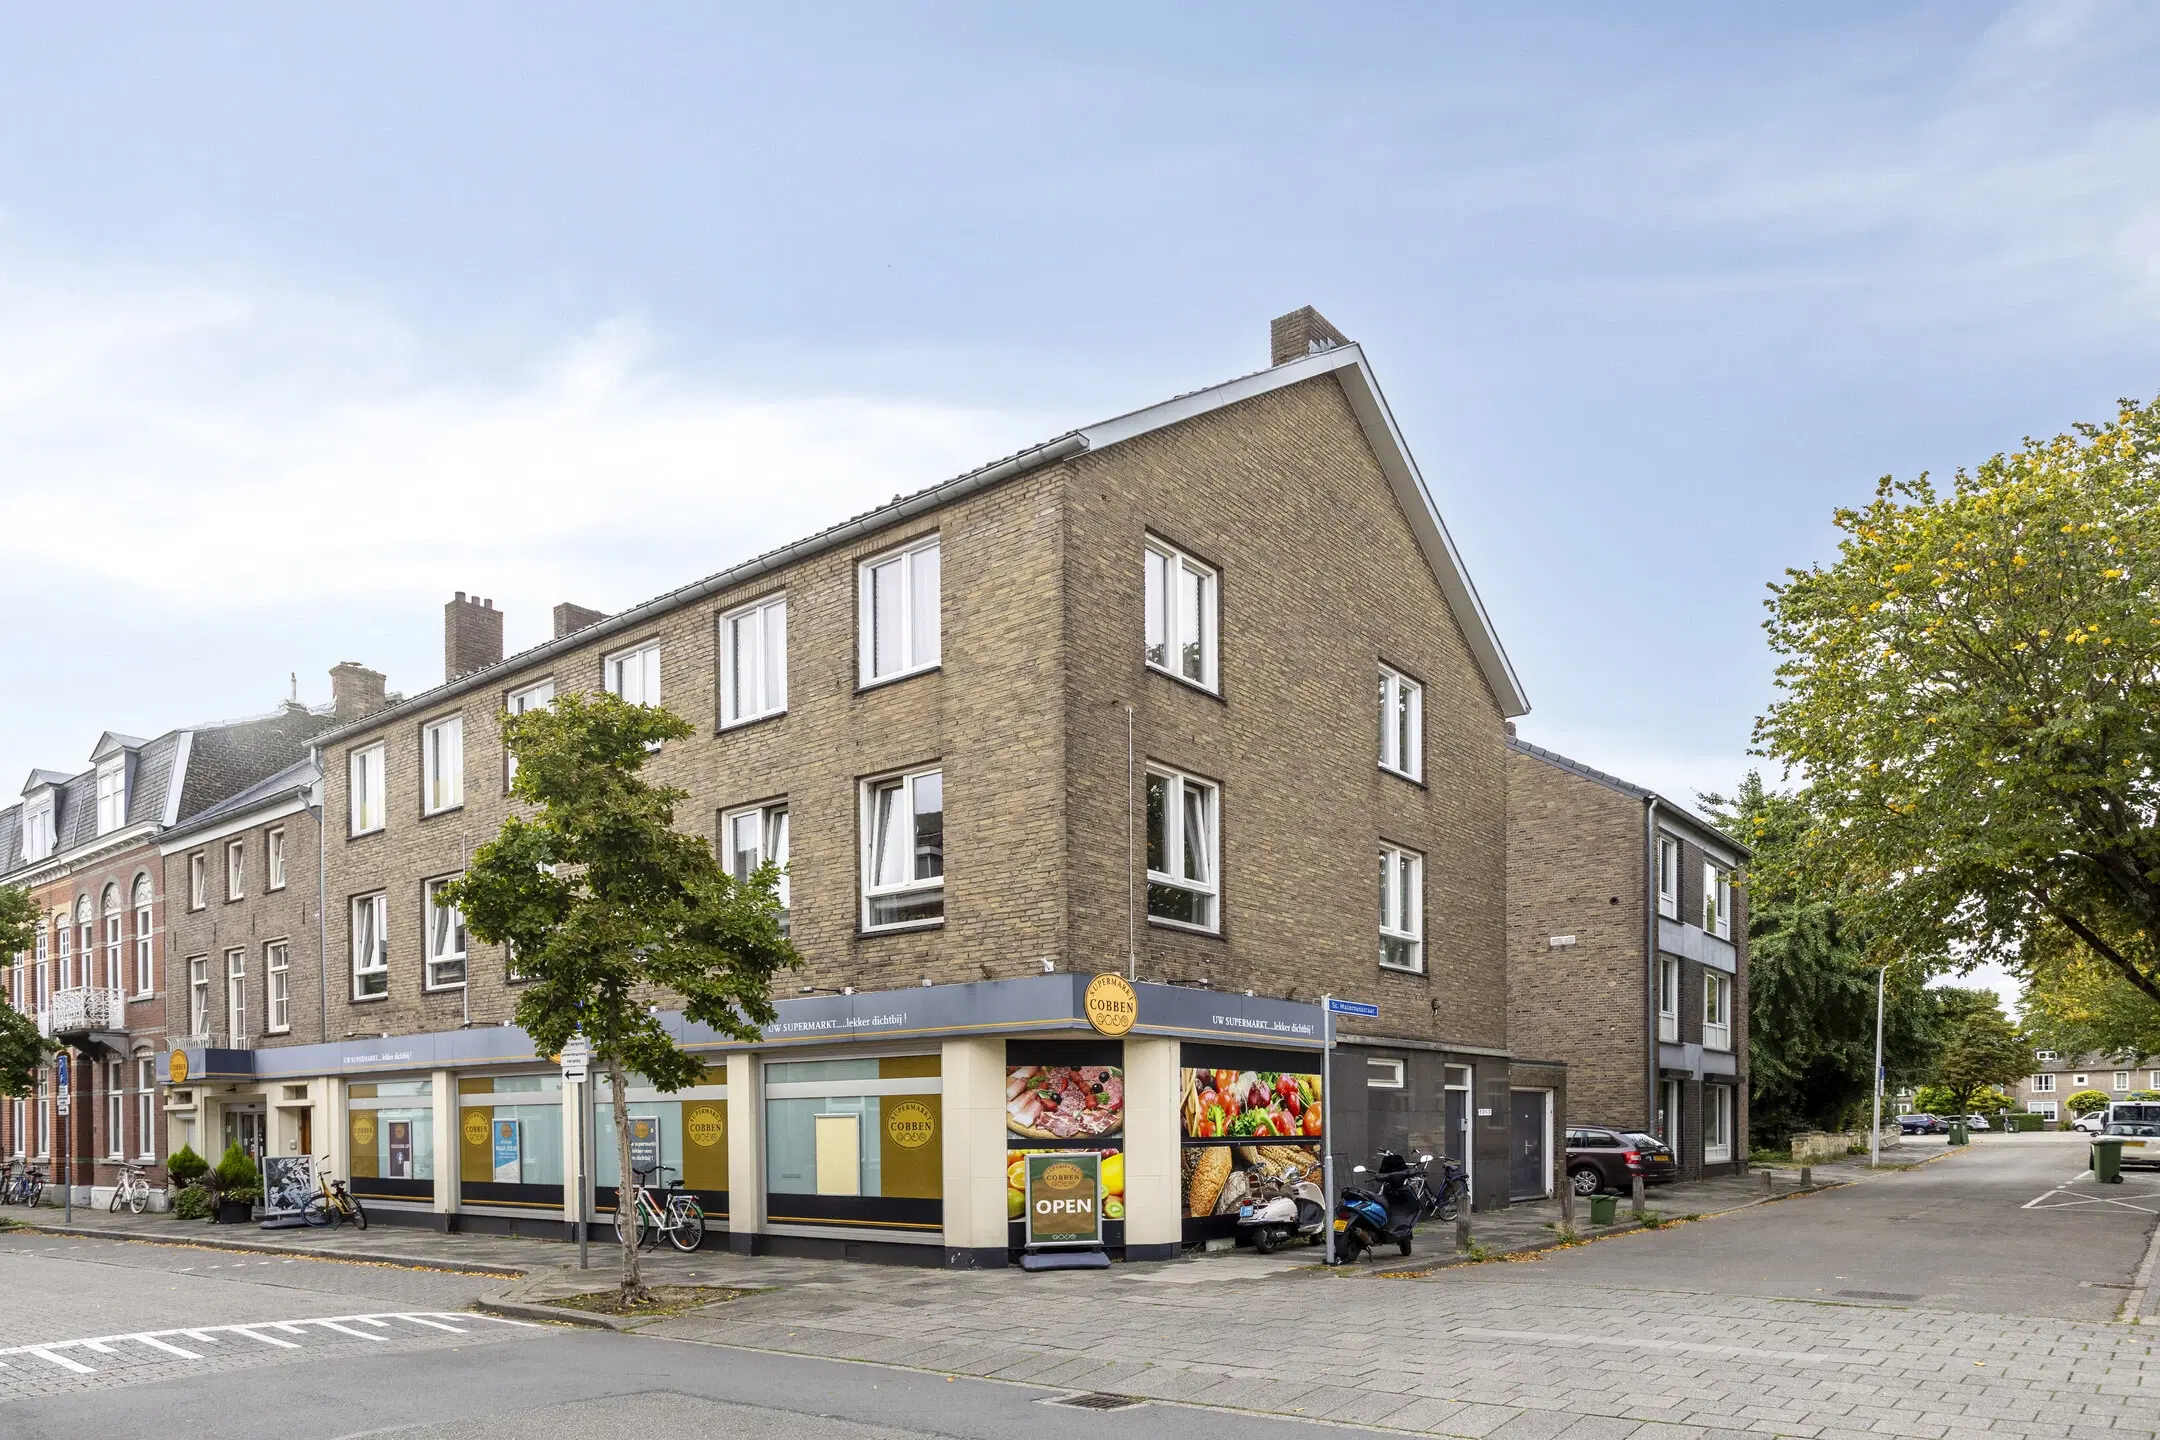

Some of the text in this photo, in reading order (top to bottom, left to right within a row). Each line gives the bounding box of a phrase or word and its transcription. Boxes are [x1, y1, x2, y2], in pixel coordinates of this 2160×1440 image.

[1090, 977, 1135, 1001] SUPERMARKT
[1090, 999, 1133, 1013] COBBEN
[768, 1024, 781, 1033] UW
[871, 1014, 902, 1026] dichtbij
[1212, 1015, 1225, 1025] UW
[690, 1109, 721, 1123] SUPERMARKT
[891, 1104, 932, 1121] SUPERMARKT
[465, 1125, 488, 1133] COBBEN
[690, 1124, 720, 1132] COBBEN
[891, 1122, 931, 1131] COBBEN
[1047, 1164, 1081, 1175] SUPERMARKT
[1036, 1198, 1092, 1214] OPEN
